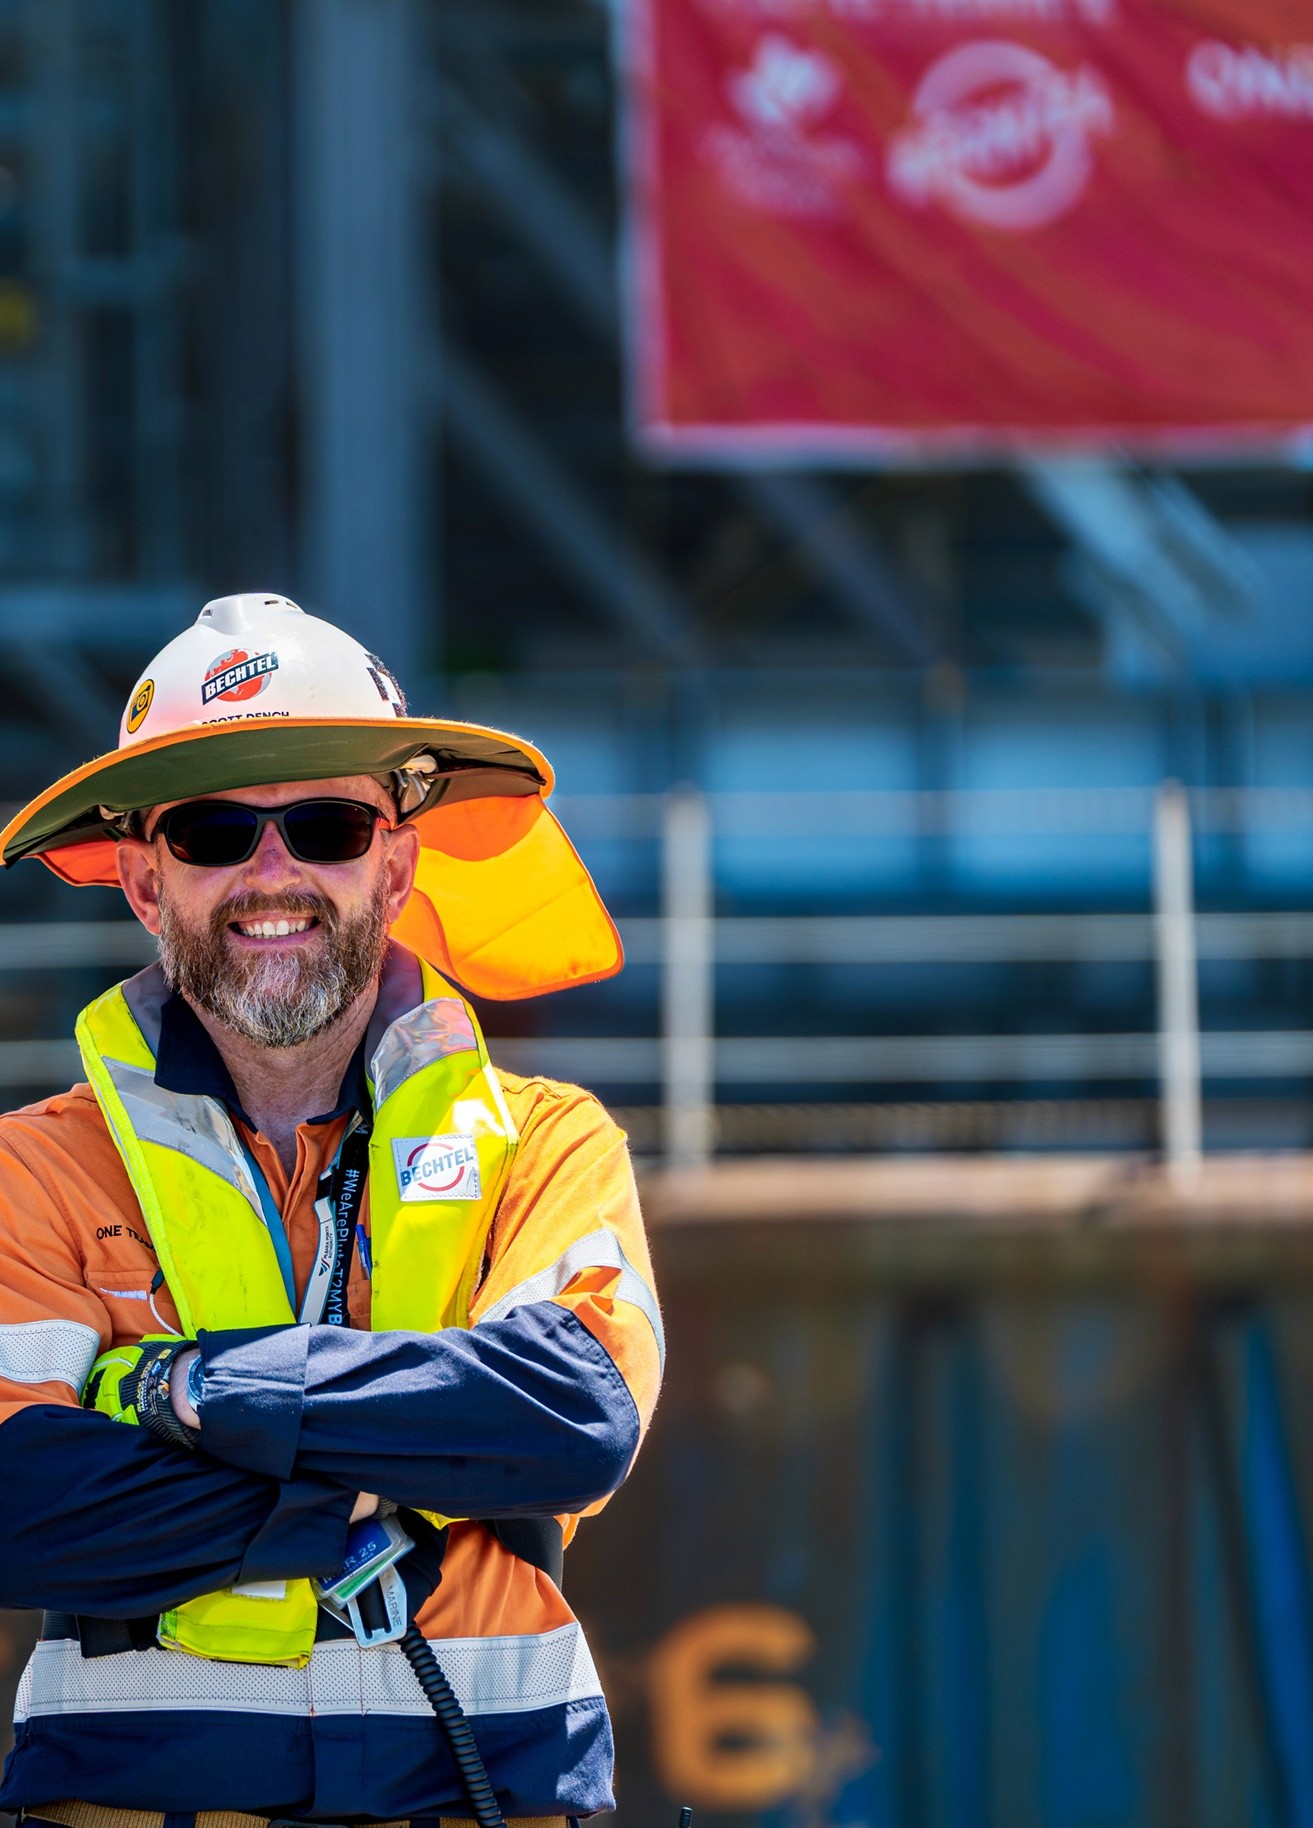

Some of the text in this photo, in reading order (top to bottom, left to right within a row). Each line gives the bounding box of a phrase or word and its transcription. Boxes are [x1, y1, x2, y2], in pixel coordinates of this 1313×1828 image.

[205, 656, 276, 700] BECHTEL
[400, 1147, 475, 1188] BECHTEL
[96, 1224, 122, 1240] ONE
[358, 1541, 377, 1558] 25
[387, 1585, 403, 1627] MARINE
